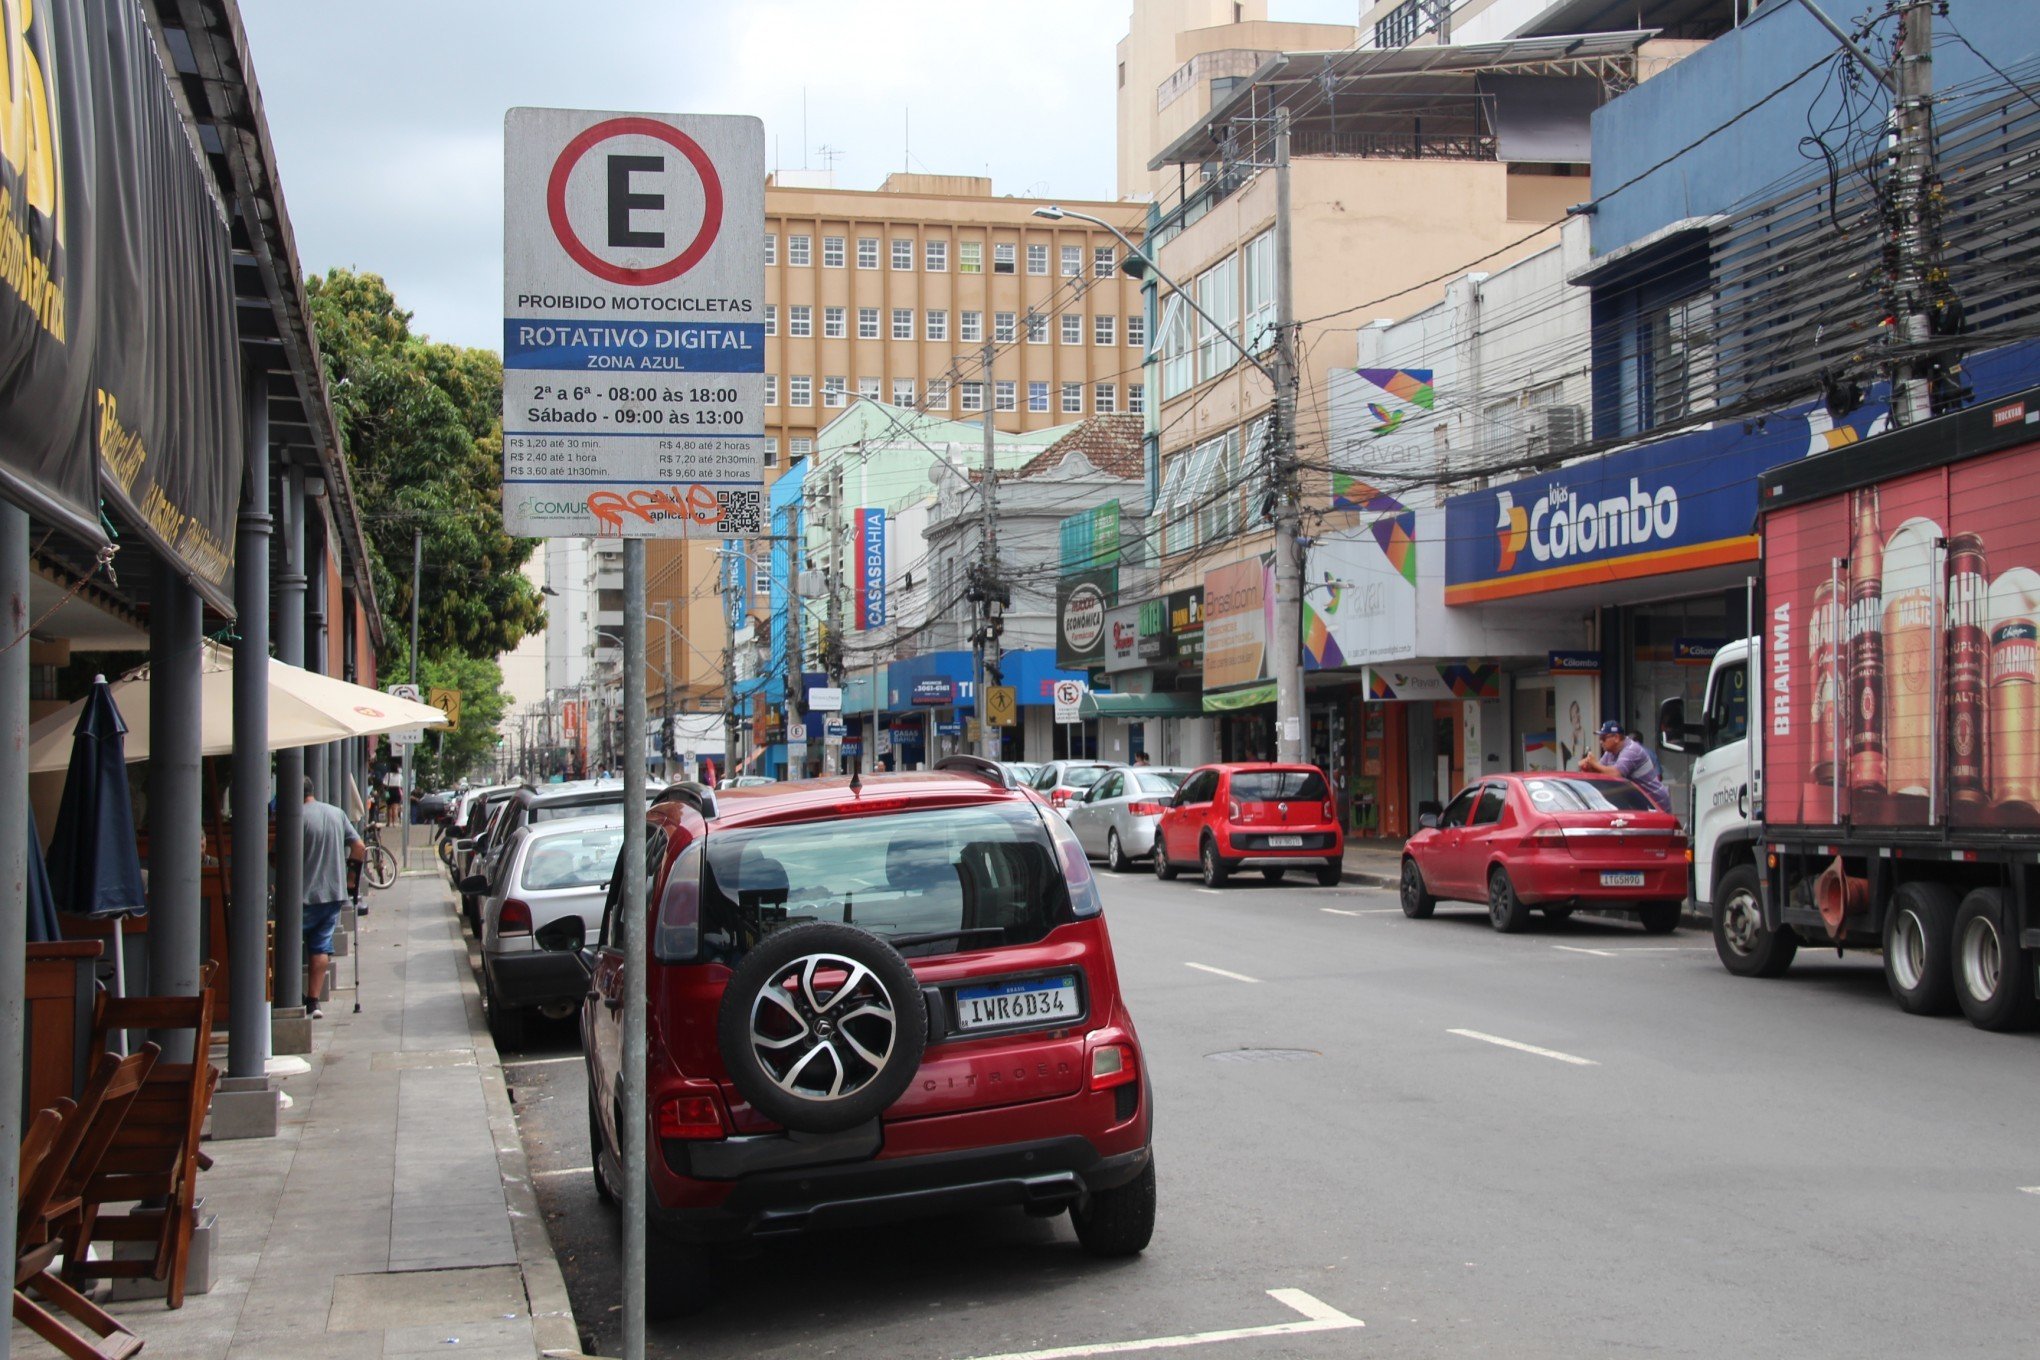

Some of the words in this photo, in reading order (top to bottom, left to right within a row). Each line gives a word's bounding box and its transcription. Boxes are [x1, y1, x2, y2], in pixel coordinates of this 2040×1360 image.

[607, 154, 665, 248] E
[518, 294, 606, 310] PROIBIDO
[611, 296, 752, 312] MOTOCICLETAS
[520, 326, 648, 348] ROTATIVO
[655, 329, 752, 349] DIGITAL
[588, 355, 635, 368] ZONA
[640, 356, 685, 370] AZUL
[534, 386, 552, 400] 2ª
[557, 389, 568, 401] a
[573, 386, 591, 401] 6ª
[608, 387, 657, 402] 08:00
[662, 387, 684, 402] às
[689, 388, 738, 403] 18:00
[528, 407, 597, 423] Sábado
[615, 409, 663, 424] 09:00
[669, 409, 690, 424] às
[696, 410, 744, 425] 13:00
[510, 439, 523, 448] R$
[526, 439, 546, 449] 1,20
[549, 439, 564, 448] até
[567, 439, 579, 448] 30
[659, 441, 672, 450] R$
[675, 441, 695, 451] 4,80
[698, 441, 713, 450] até
[715, 441, 722, 450] 2
[724, 441, 750, 450] horas
[1346, 438, 1421, 462] Pavan
[510, 453, 523, 462] R$
[526, 453, 546, 463] 2,40
[549, 453, 564, 462] até
[568, 453, 573, 462] 1
[575, 453, 597, 462] hora
[659, 455, 672, 464] R$
[675, 455, 695, 465] 7,20
[698, 455, 713, 464] até
[510, 467, 523, 476] R$
[526, 467, 546, 477] 3,60
[549, 467, 564, 476] até
[659, 469, 672, 478] R$
[675, 469, 695, 479] 9,60
[698, 469, 713, 478] até
[715, 469, 722, 478] 3
[724, 469, 750, 478] horas
[1549, 482, 1568, 510] lojas
[534, 501, 590, 514] COMUR
[1530, 477, 1678, 562] Colombo
[1563, 656, 1598, 667] Colombo
[1773, 601, 1790, 736] BRAHMA
[1411, 677, 1440, 688] Pavan
[1712, 785, 1738, 806] ambev
[971, 990, 1065, 1023] IWR6D34
